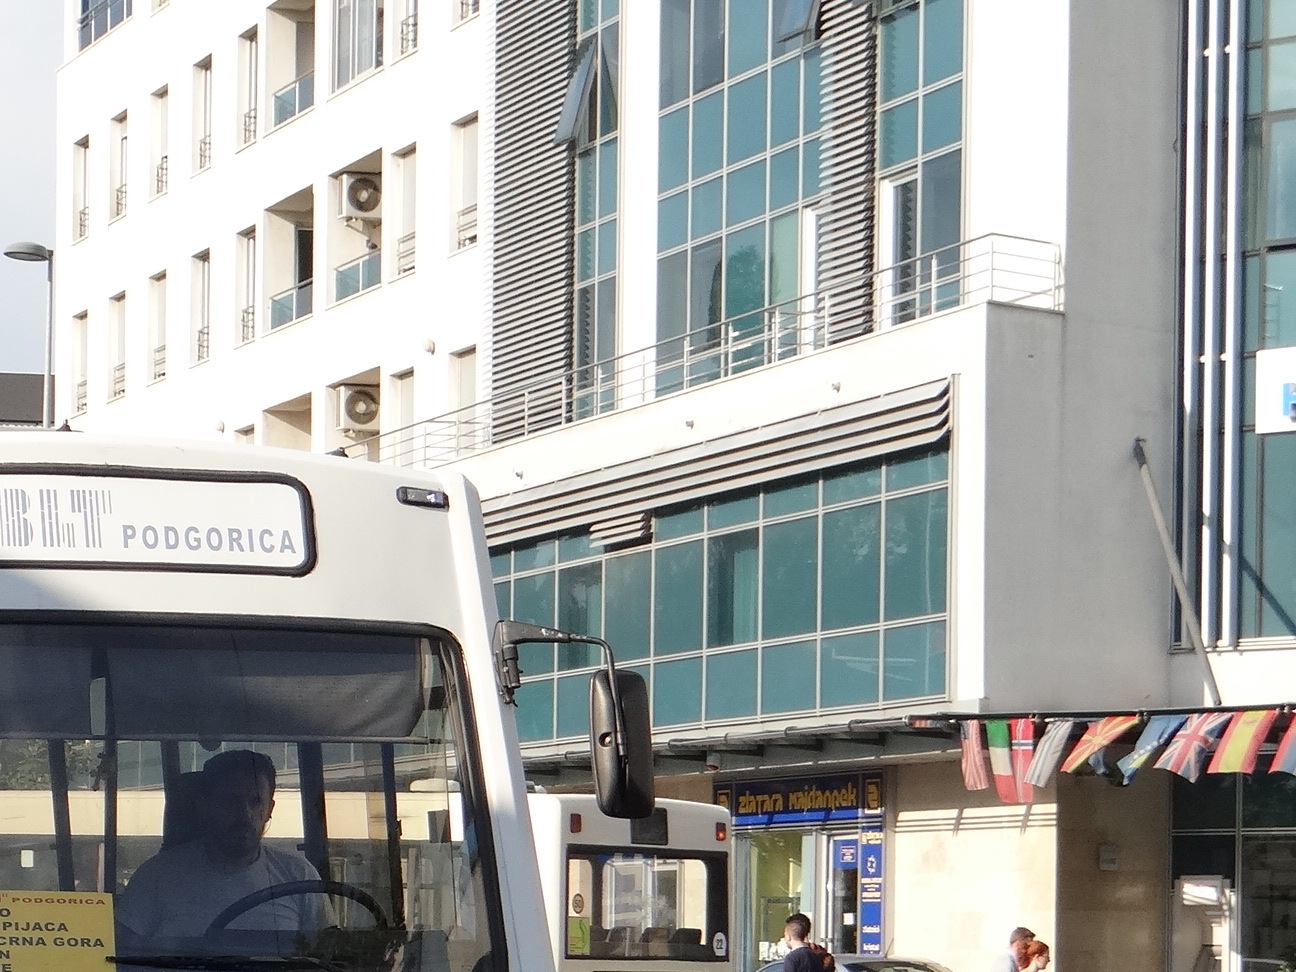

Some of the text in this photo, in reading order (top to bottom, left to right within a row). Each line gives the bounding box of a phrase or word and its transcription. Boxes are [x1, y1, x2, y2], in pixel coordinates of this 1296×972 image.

[122, 523, 298, 555] PODGORICA
[11, 896, 106, 906] PODGORICA
[2, 921, 69, 932] PIJACA
[53, 936, 105, 948] GORA
